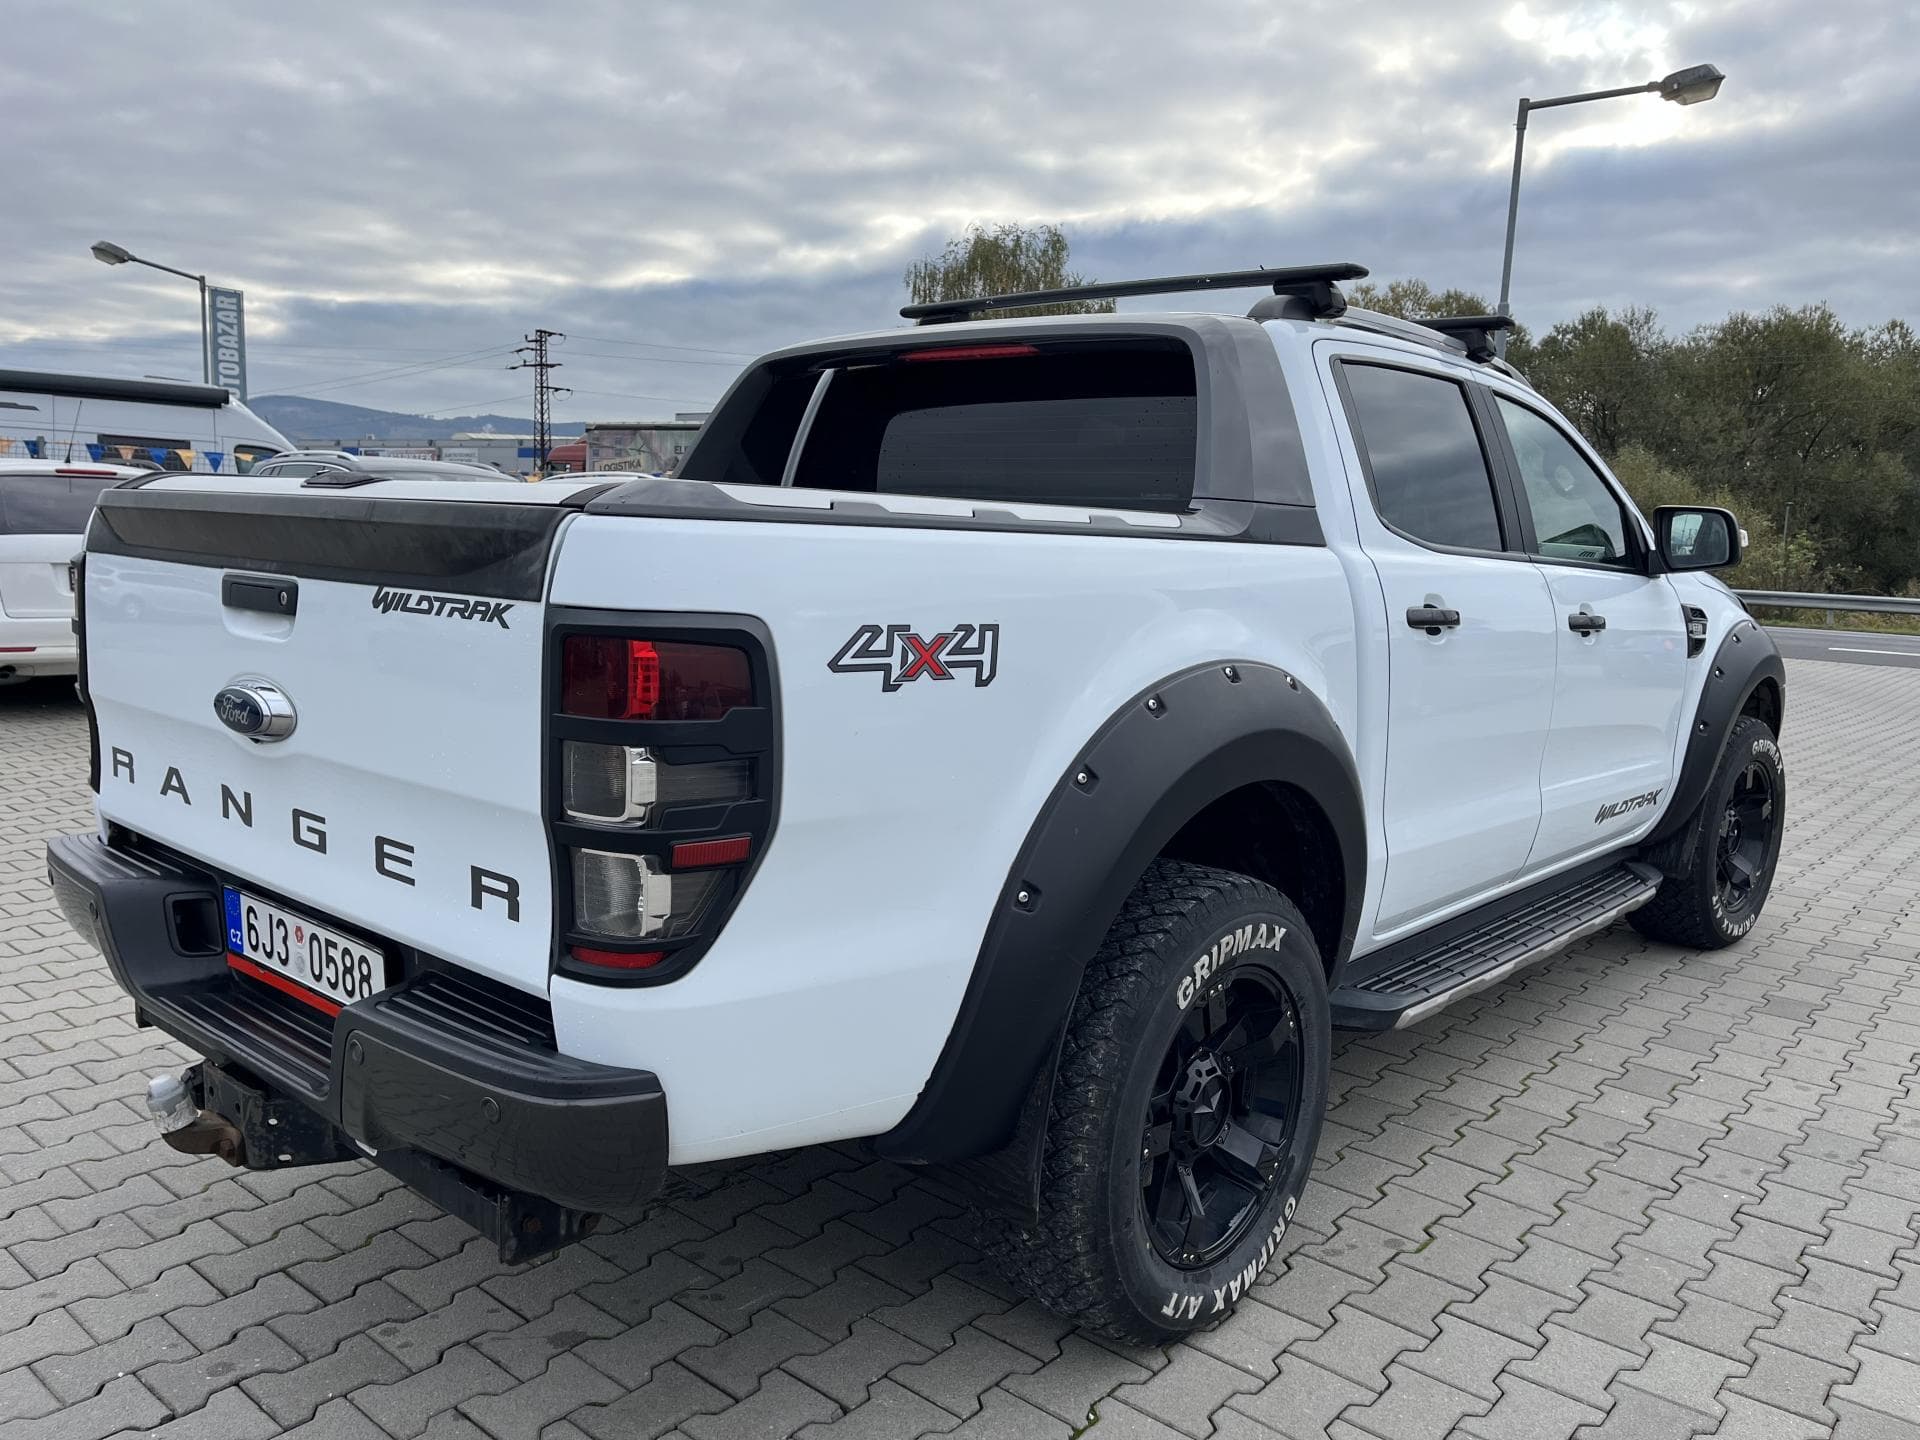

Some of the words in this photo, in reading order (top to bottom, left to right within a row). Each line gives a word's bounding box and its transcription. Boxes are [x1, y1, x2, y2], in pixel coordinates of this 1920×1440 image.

[372, 585, 515, 629] WILDTRAK
[220, 694, 250, 725] Ford
[1751, 739, 1783, 775] GRIPMAX
[1594, 788, 1664, 825] WILDTRAK
[111, 746, 520, 922] RANGER
[230, 928, 242, 945] CZ
[246, 905, 290, 967] 6J3
[309, 932, 373, 1000] 0588
[1176, 923, 1287, 1010] GRIPMAX
[1210, 1196, 1296, 1314] GRIPMAX
[1161, 1292, 1204, 1320] A/T
